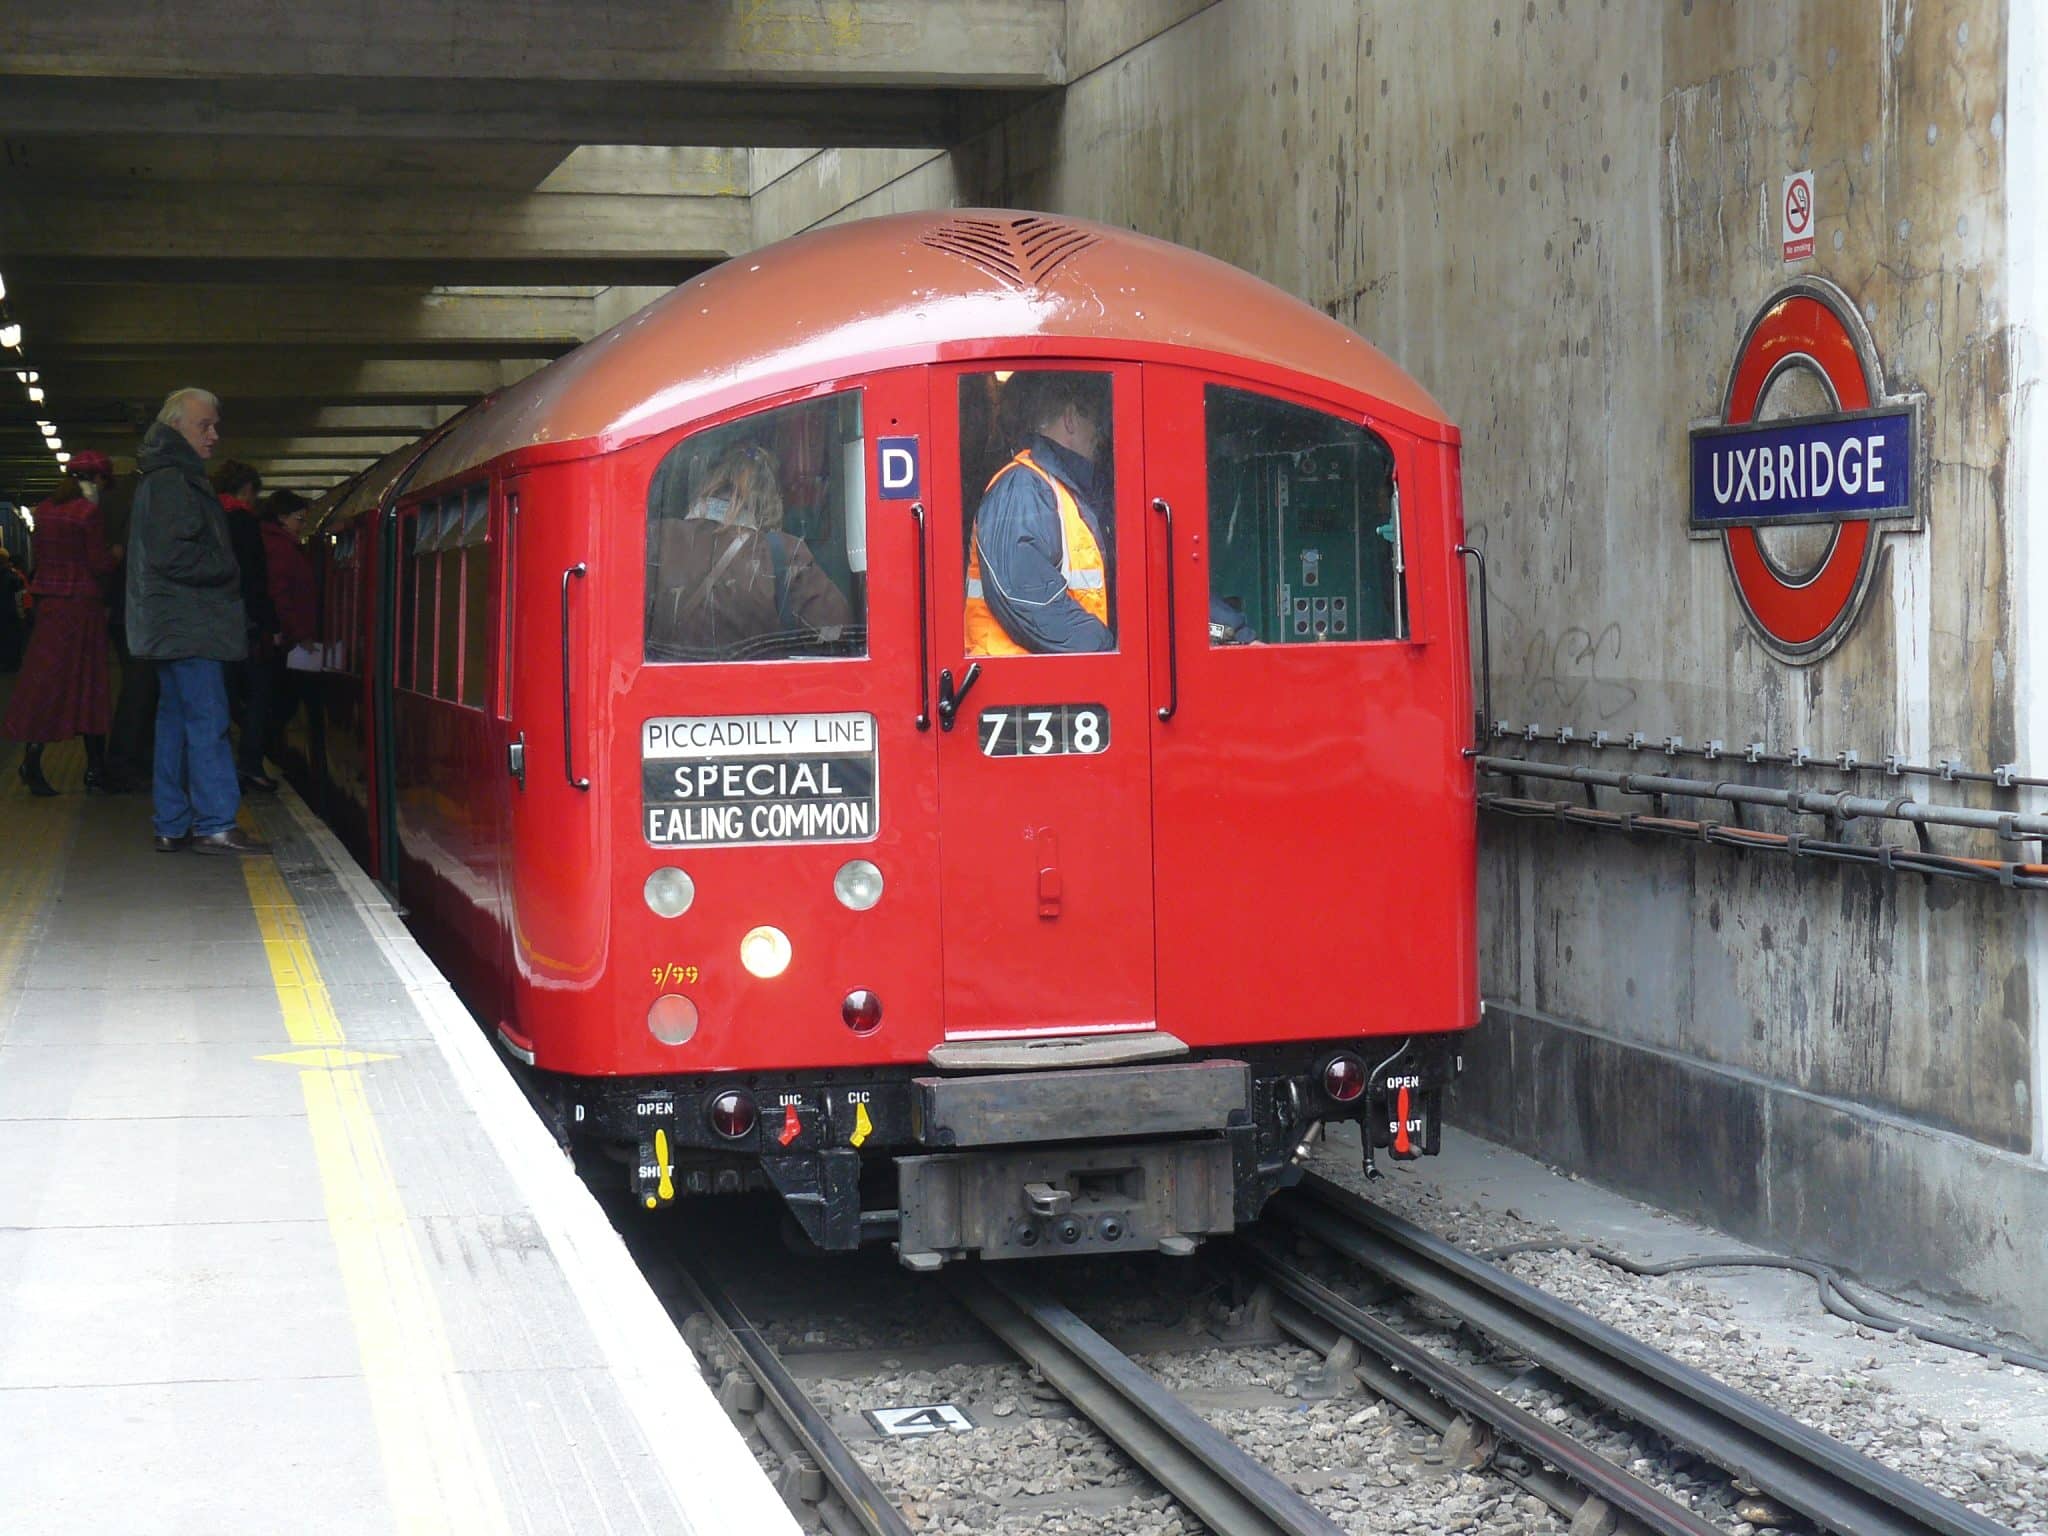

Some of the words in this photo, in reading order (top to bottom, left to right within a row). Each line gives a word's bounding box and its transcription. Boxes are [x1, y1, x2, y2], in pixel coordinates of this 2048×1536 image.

[882, 449, 913, 489] D
[1712, 435, 1885, 503] UXBRIDGE
[648, 719, 799, 749] PICCADILLY
[814, 720, 866, 743] LINE
[673, 762, 843, 798] SPECIAL
[650, 806, 744, 841] EALING
[751, 801, 869, 838] COMMON
[651, 962, 698, 991] 9/99
[1387, 1075, 1420, 1089] OPEN
[637, 1101, 673, 1116] OPEN
[848, 1091, 870, 1104] CIC
[575, 1105, 585, 1121] D
[1389, 1119, 1422, 1133] SUT
[893, 1408, 957, 1428] 4
